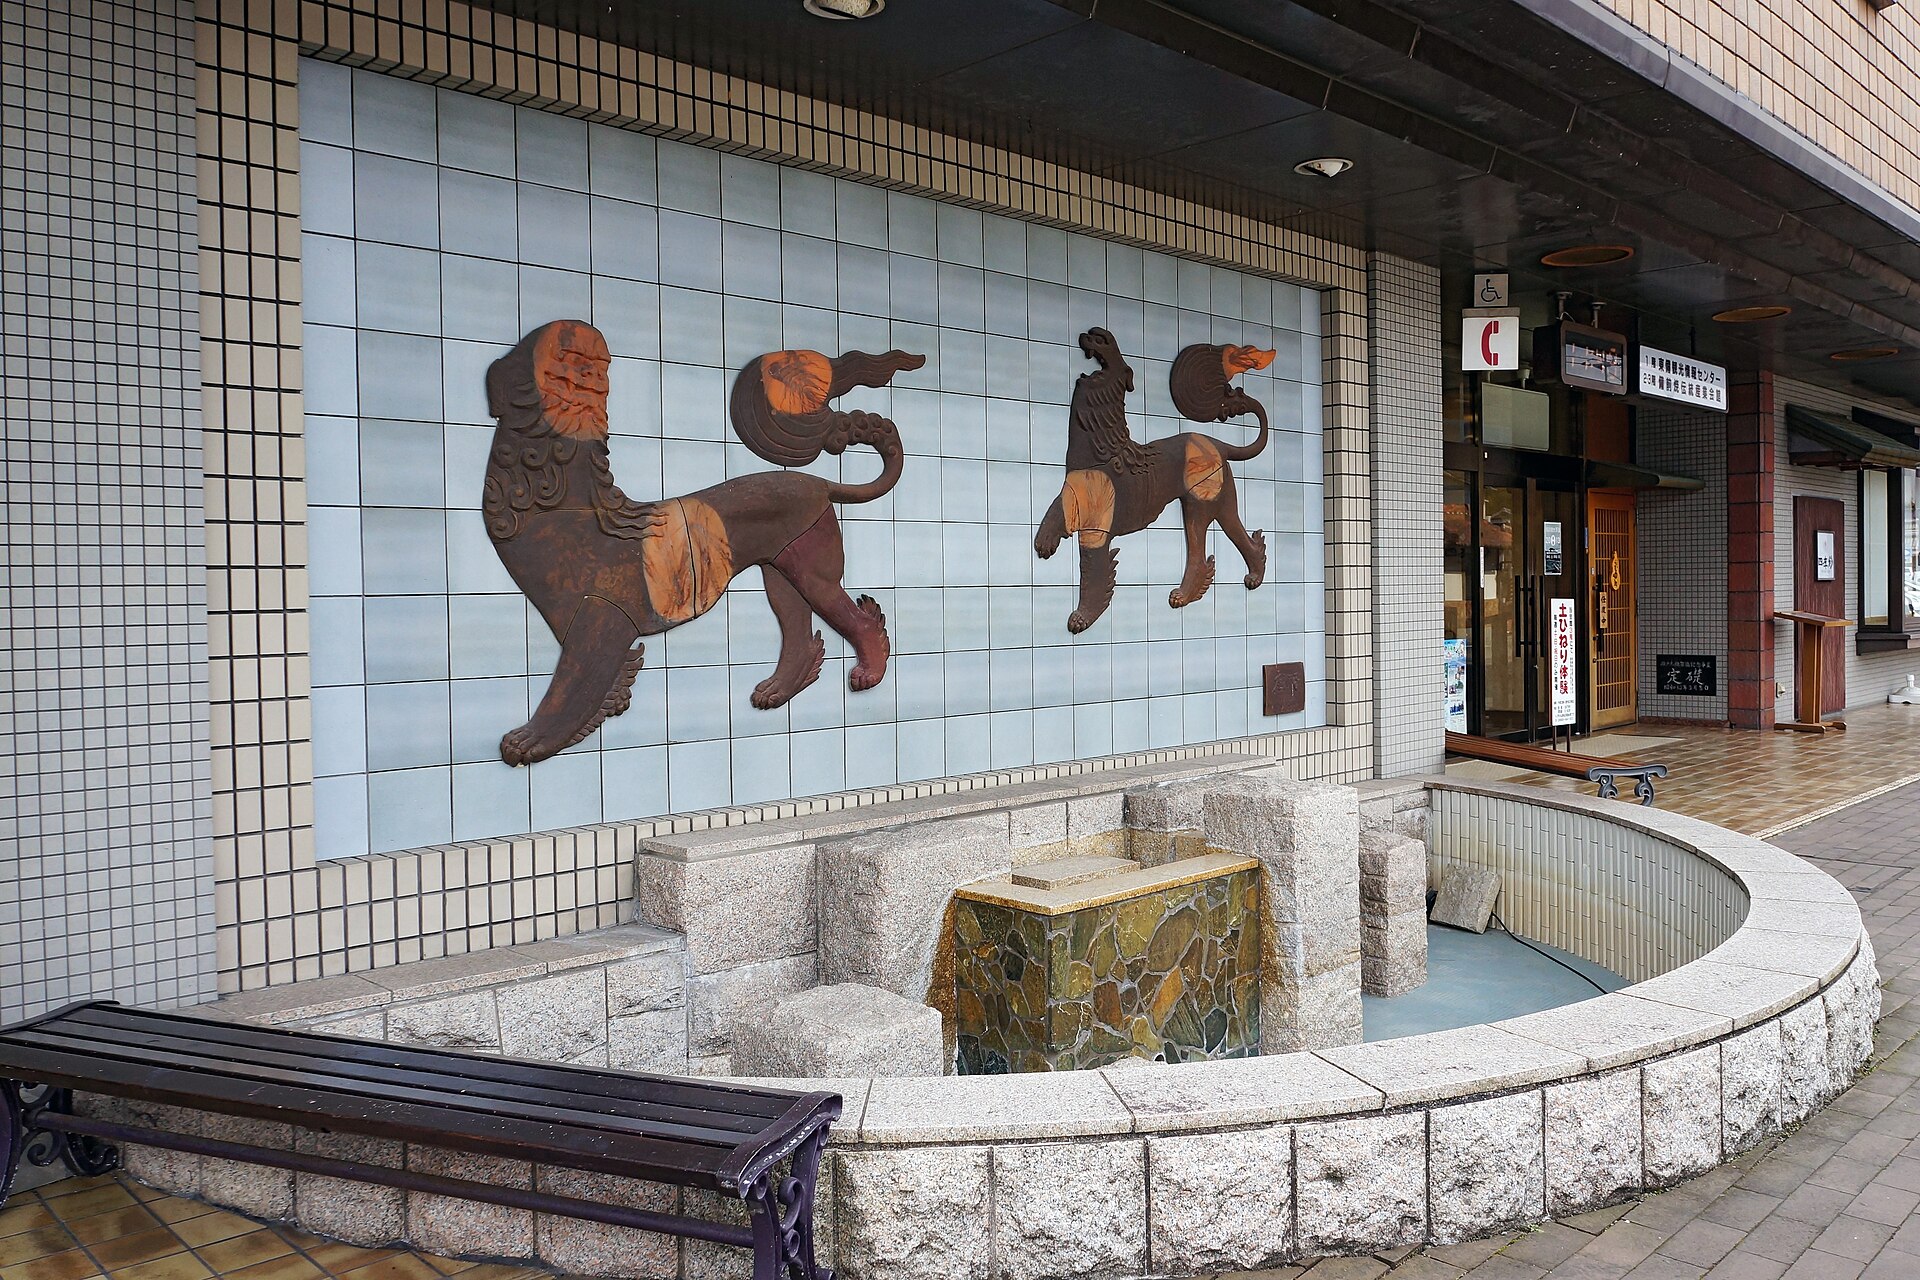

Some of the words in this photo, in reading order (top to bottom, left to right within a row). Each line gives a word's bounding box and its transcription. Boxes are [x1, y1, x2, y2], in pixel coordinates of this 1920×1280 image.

[1558, 602, 1569, 695] 土ひねり体験
